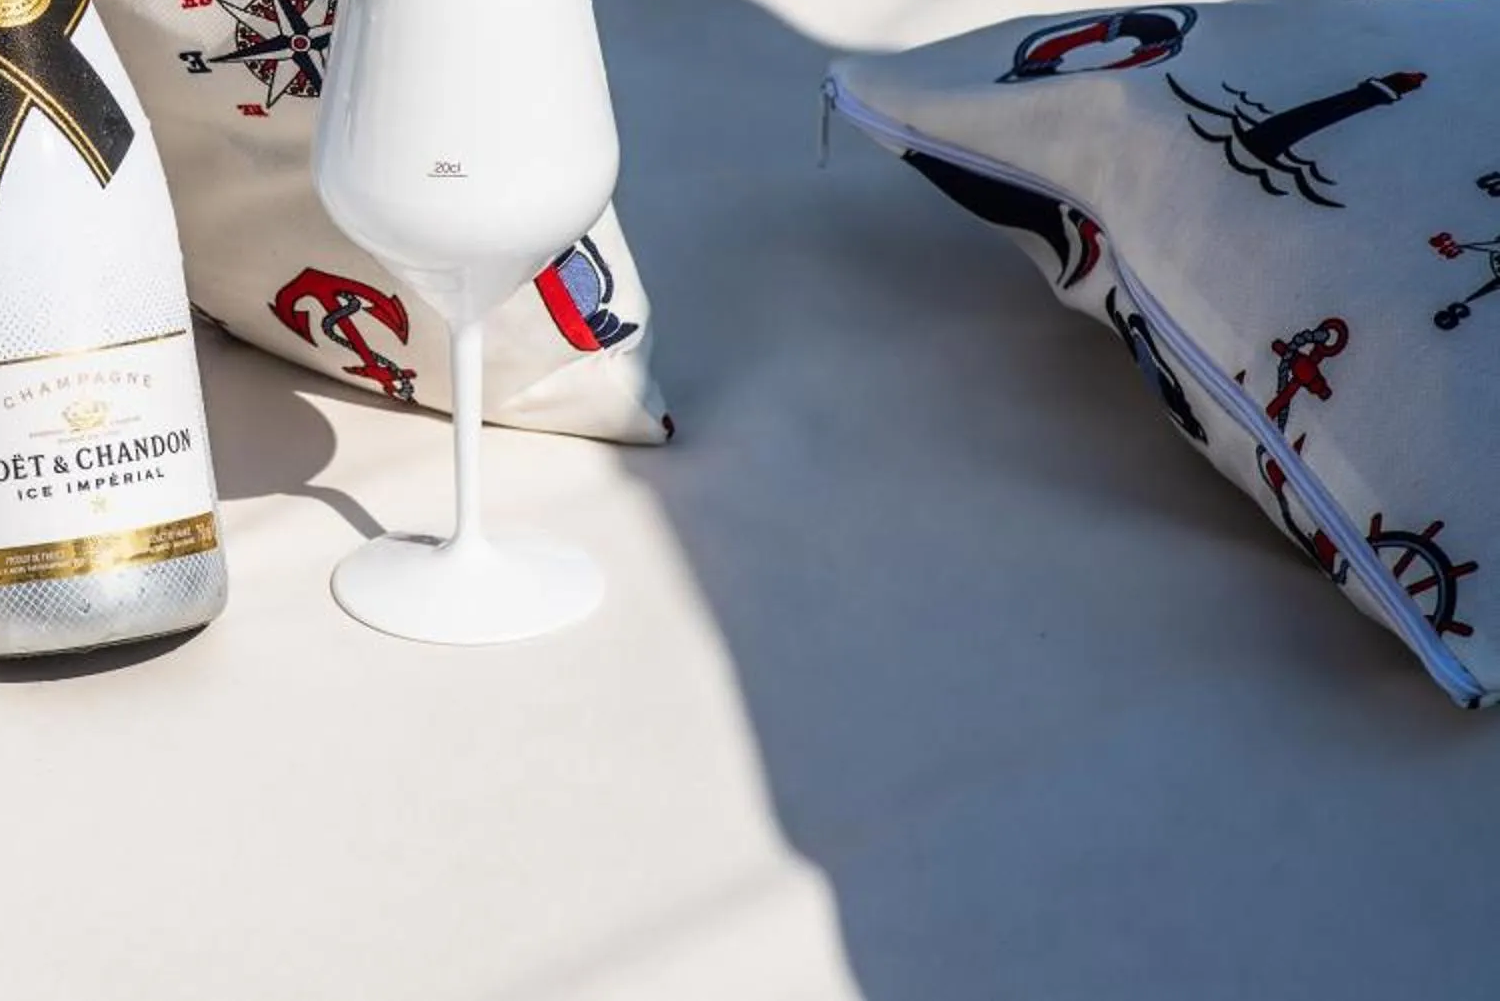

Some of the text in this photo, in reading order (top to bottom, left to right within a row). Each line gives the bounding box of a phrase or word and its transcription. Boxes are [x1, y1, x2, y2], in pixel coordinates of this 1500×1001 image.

[2, 369, 153, 410] CHAMPAGNE
[53, 455, 69, 475] &
[75, 427, 192, 471] CHANDON
[16, 466, 166, 501] ICE IMPÉRIAL
